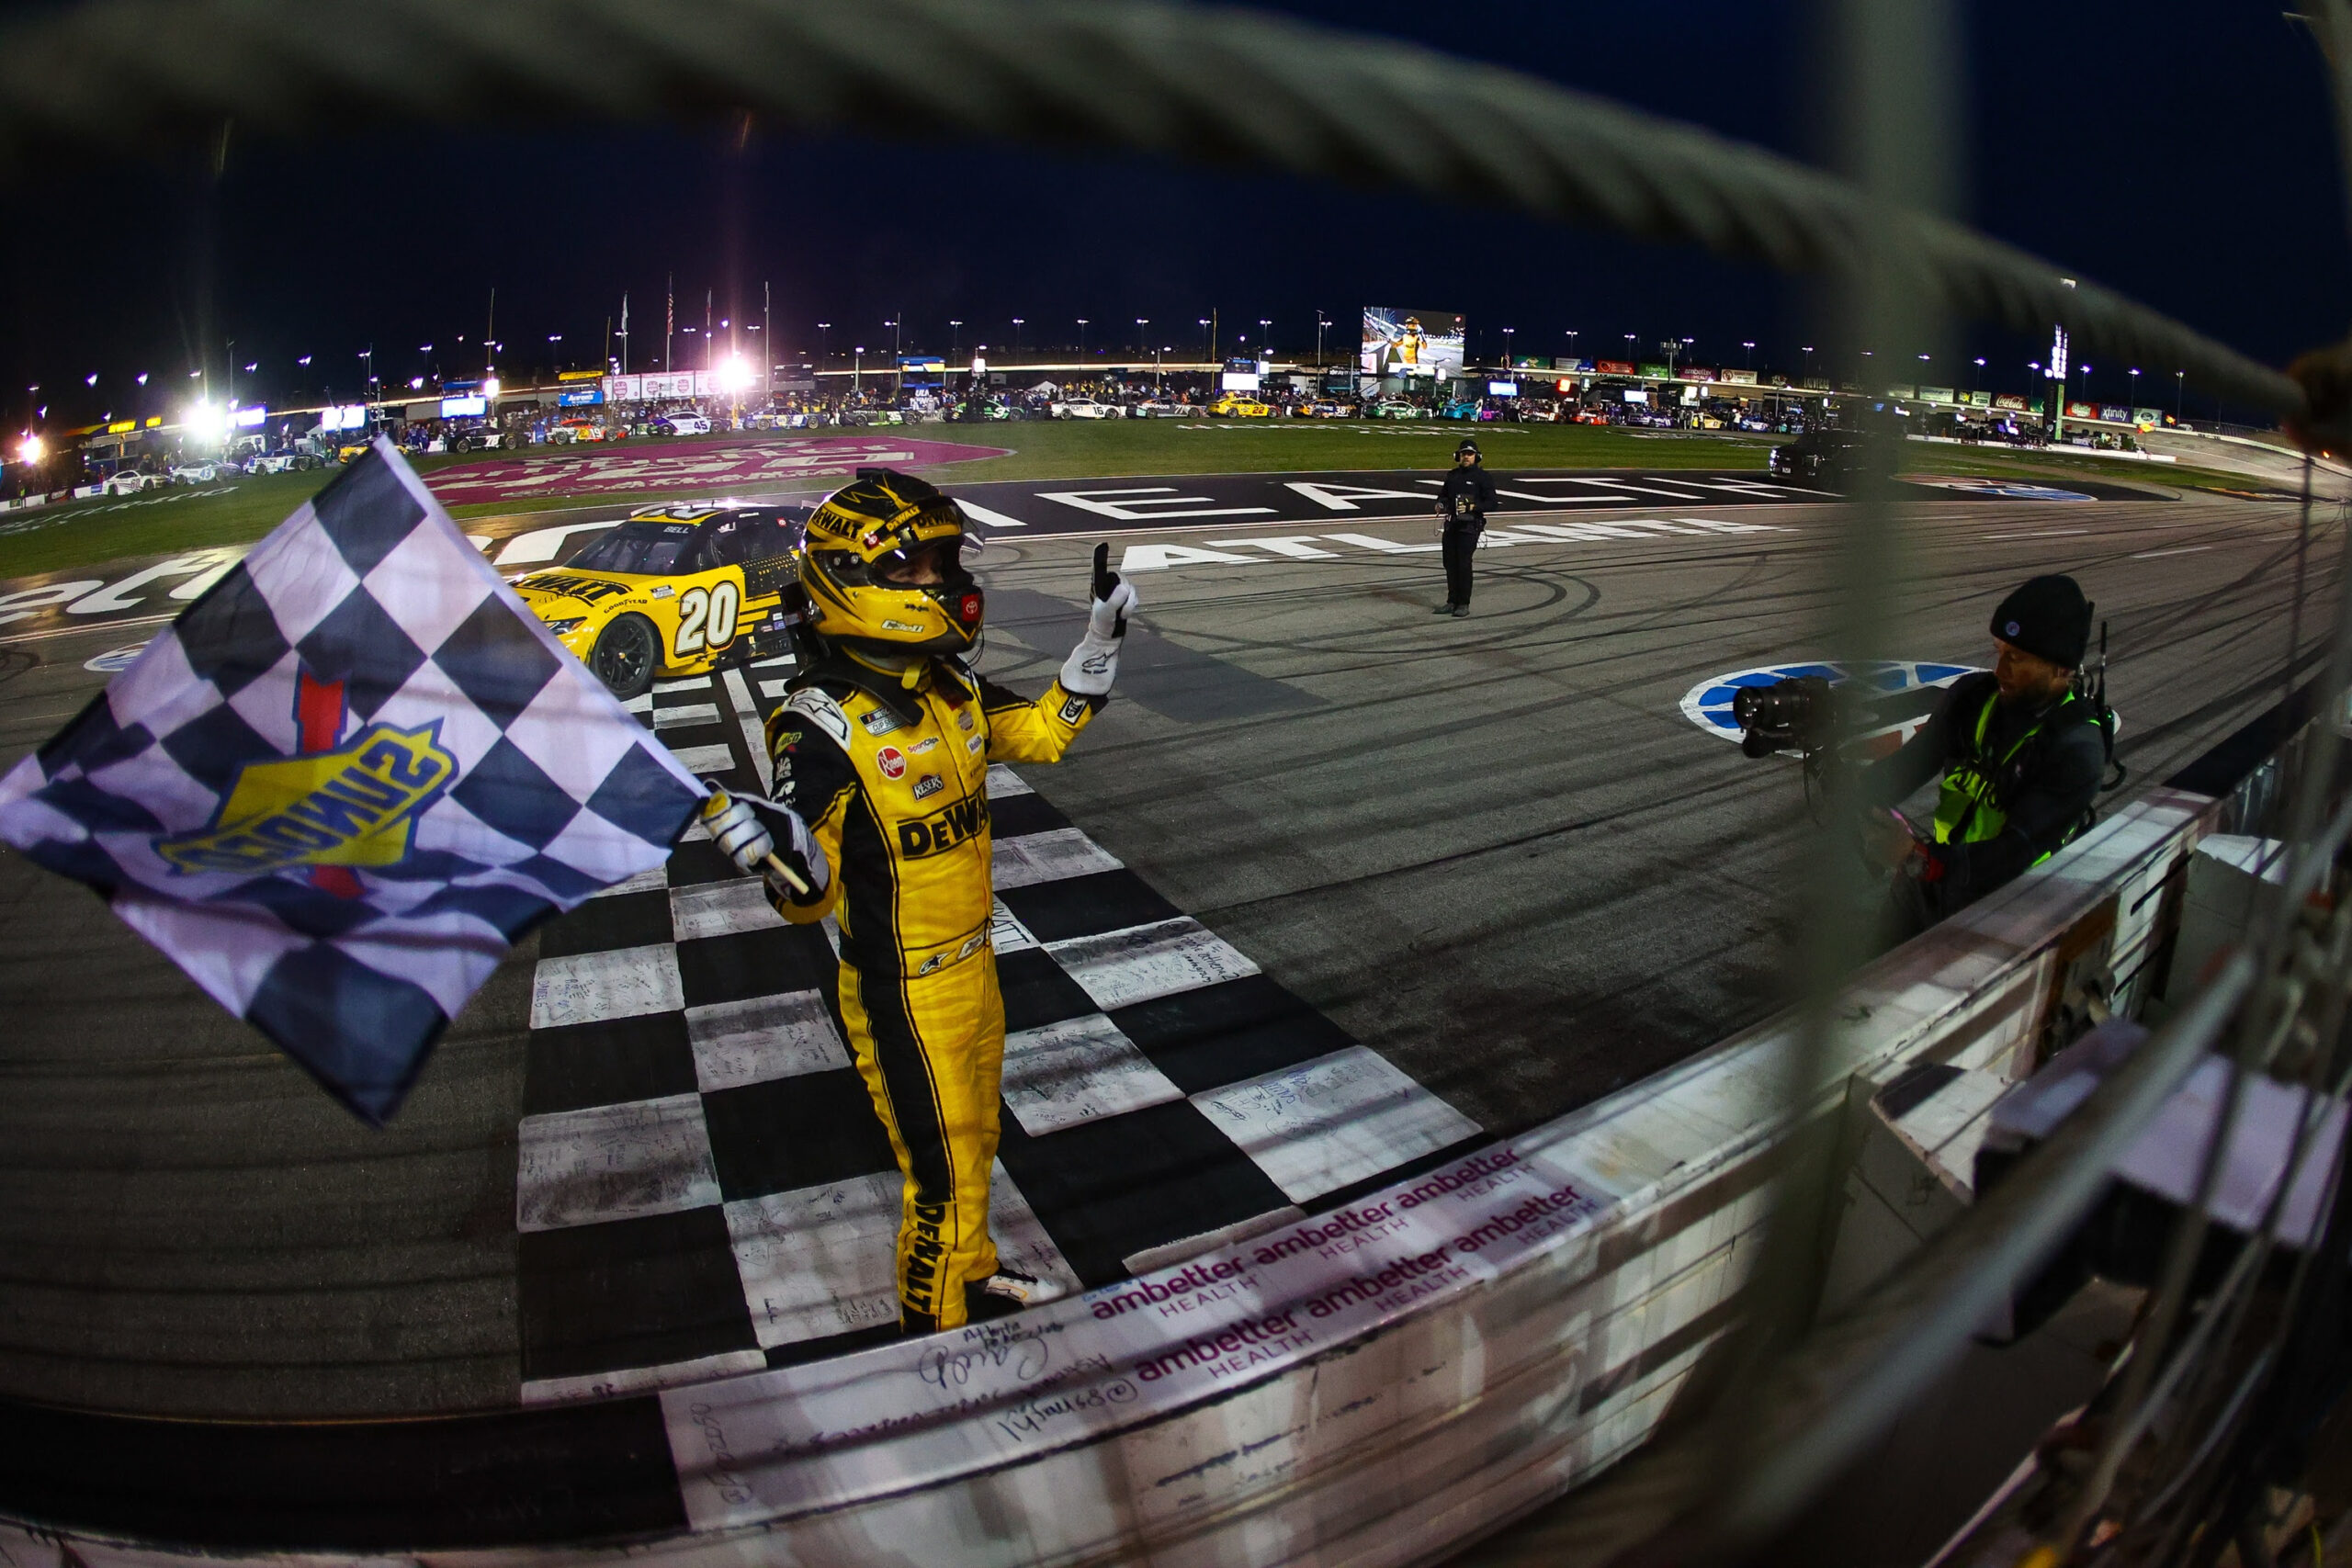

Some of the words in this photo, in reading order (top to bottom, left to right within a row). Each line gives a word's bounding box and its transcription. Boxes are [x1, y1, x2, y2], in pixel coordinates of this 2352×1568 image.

[591, 428, 603, 438] 19
[694, 420, 707, 430] 45
[1092, 406, 1104, 415] 16
[1406, 408, 1418, 416] 42
[2102, 406, 2129, 423] xfinity
[199, 468, 211, 479] 43
[662, 525, 690, 535] BELL
[1120, 518, 1799, 573] ATLANTA
[603, 598, 648, 615] GOODYEAR
[674, 582, 739, 658] 20
[879, 750, 906, 774] Rheem
[897, 795, 989, 857] DEWA
[1396, 1148, 1521, 1208] ambetter
[1457, 1161, 1535, 1202] HEALTH
[1253, 1201, 1394, 1264] ambetter
[1317, 1217, 1409, 1259] HEALTH
[1453, 1185, 1582, 1253] ambetter
[1516, 1197, 1600, 1246] HEALTH
[906, 1203, 946, 1314] DEWALT
[1091, 1256, 1244, 1320] ambetter
[1159, 1275, 1261, 1317] HEALTH
[1305, 1247, 1453, 1318] ambetter
[1374, 1266, 1470, 1313] HEALTH
[1134, 1310, 1298, 1382] ambetter
[1207, 1328, 1314, 1379] HEALTH
